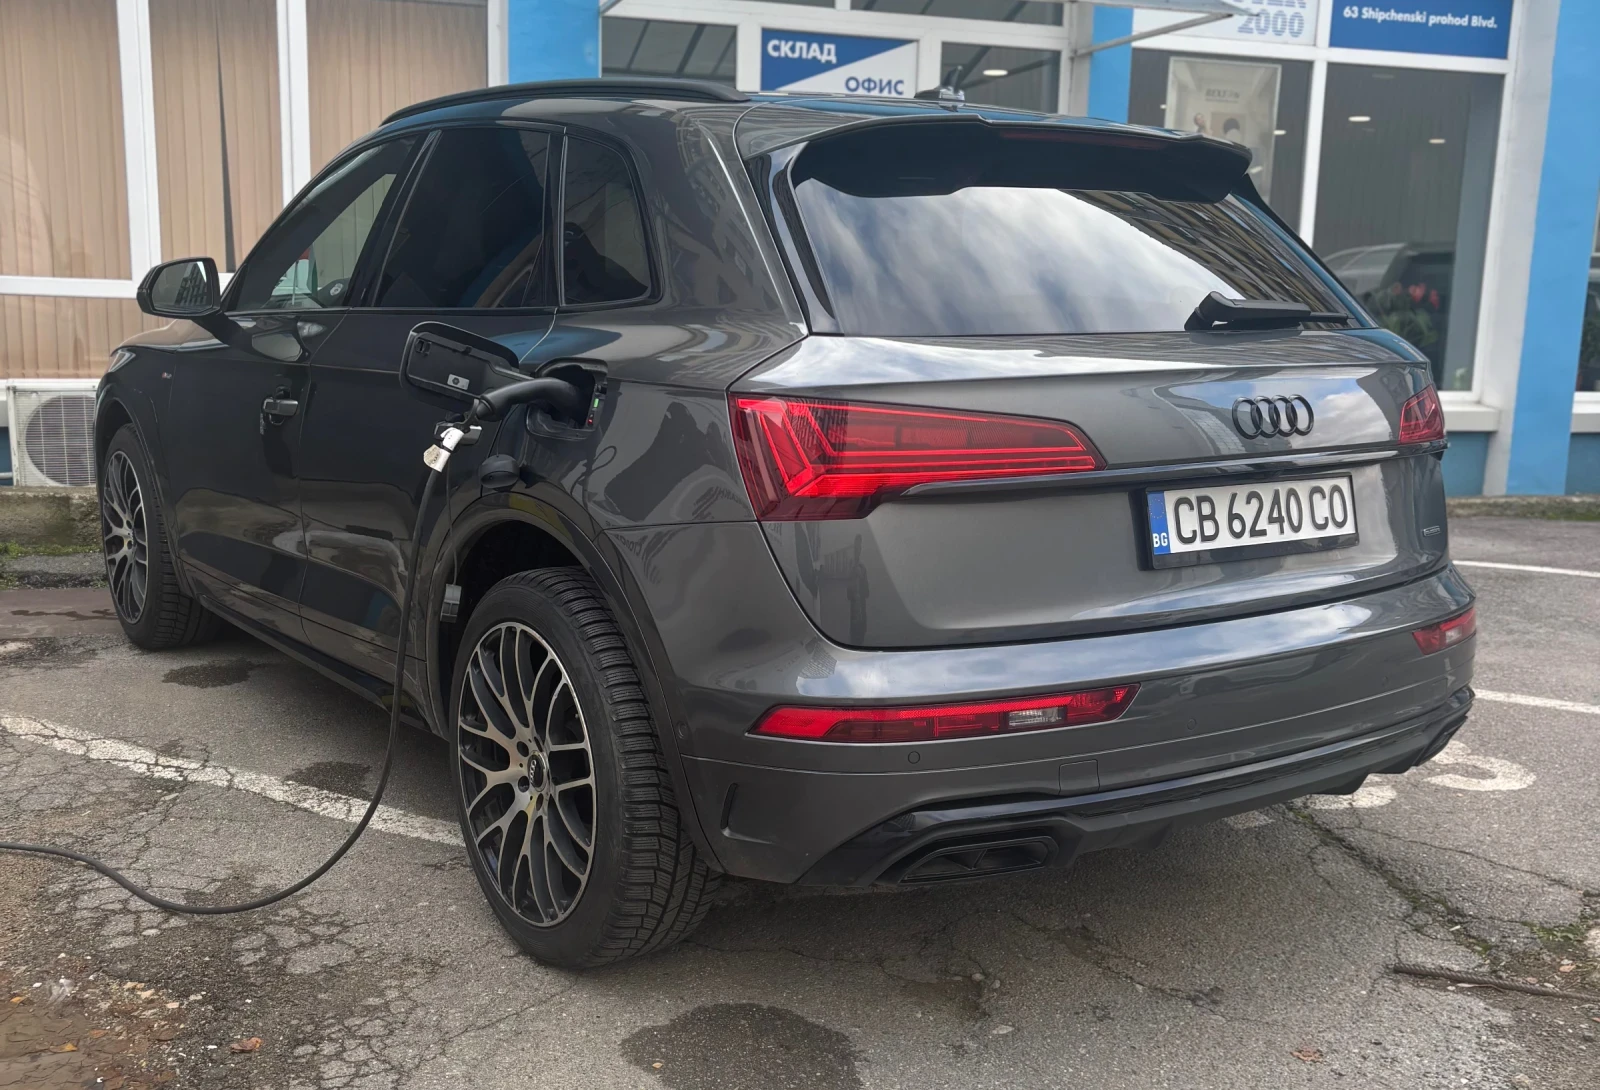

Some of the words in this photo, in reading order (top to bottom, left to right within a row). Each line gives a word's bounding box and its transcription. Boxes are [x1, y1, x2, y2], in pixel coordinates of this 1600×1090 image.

[1343, 6, 1359, 18] 63
[1361, 7, 1427, 23] Shipchenski
[1428, 13, 1469, 27] prohod
[1471, 15, 1498, 28] Blvd.
[767, 39, 837, 64] СКЛАД
[845, 76, 904, 95] ОФИС
[1173, 494, 1220, 545] CB
[1227, 487, 1303, 539] 6240
[1308, 484, 1349, 531] CO
[1152, 531, 1169, 548] BG
